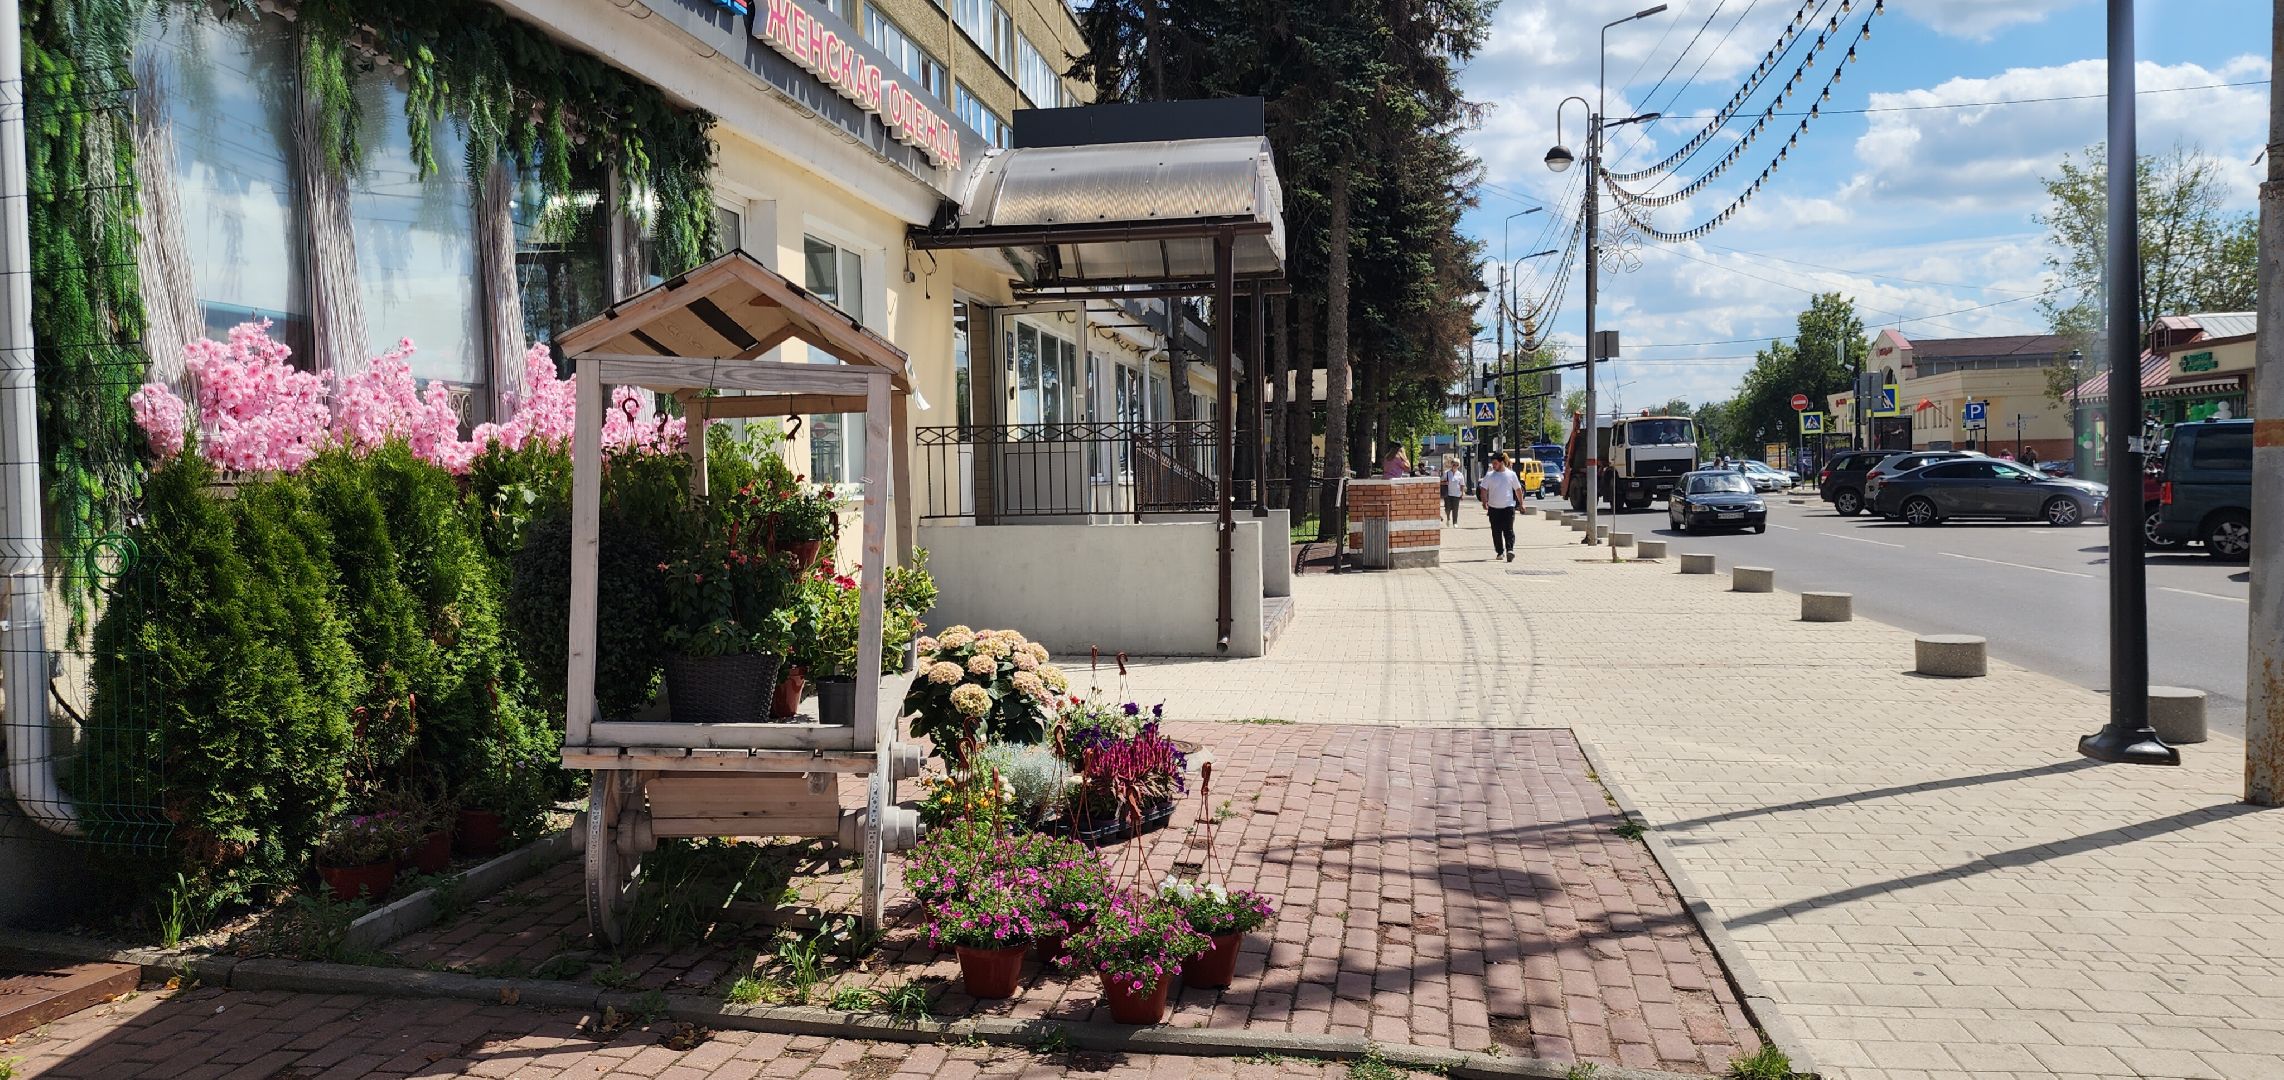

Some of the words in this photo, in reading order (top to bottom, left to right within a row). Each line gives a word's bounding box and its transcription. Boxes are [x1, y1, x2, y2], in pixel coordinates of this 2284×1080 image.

[766, 0, 881, 114] ЖЕНСКАЯ
[889, 81, 961, 171] ОДЕЖДА
[1970, 404, 1981, 419] P
